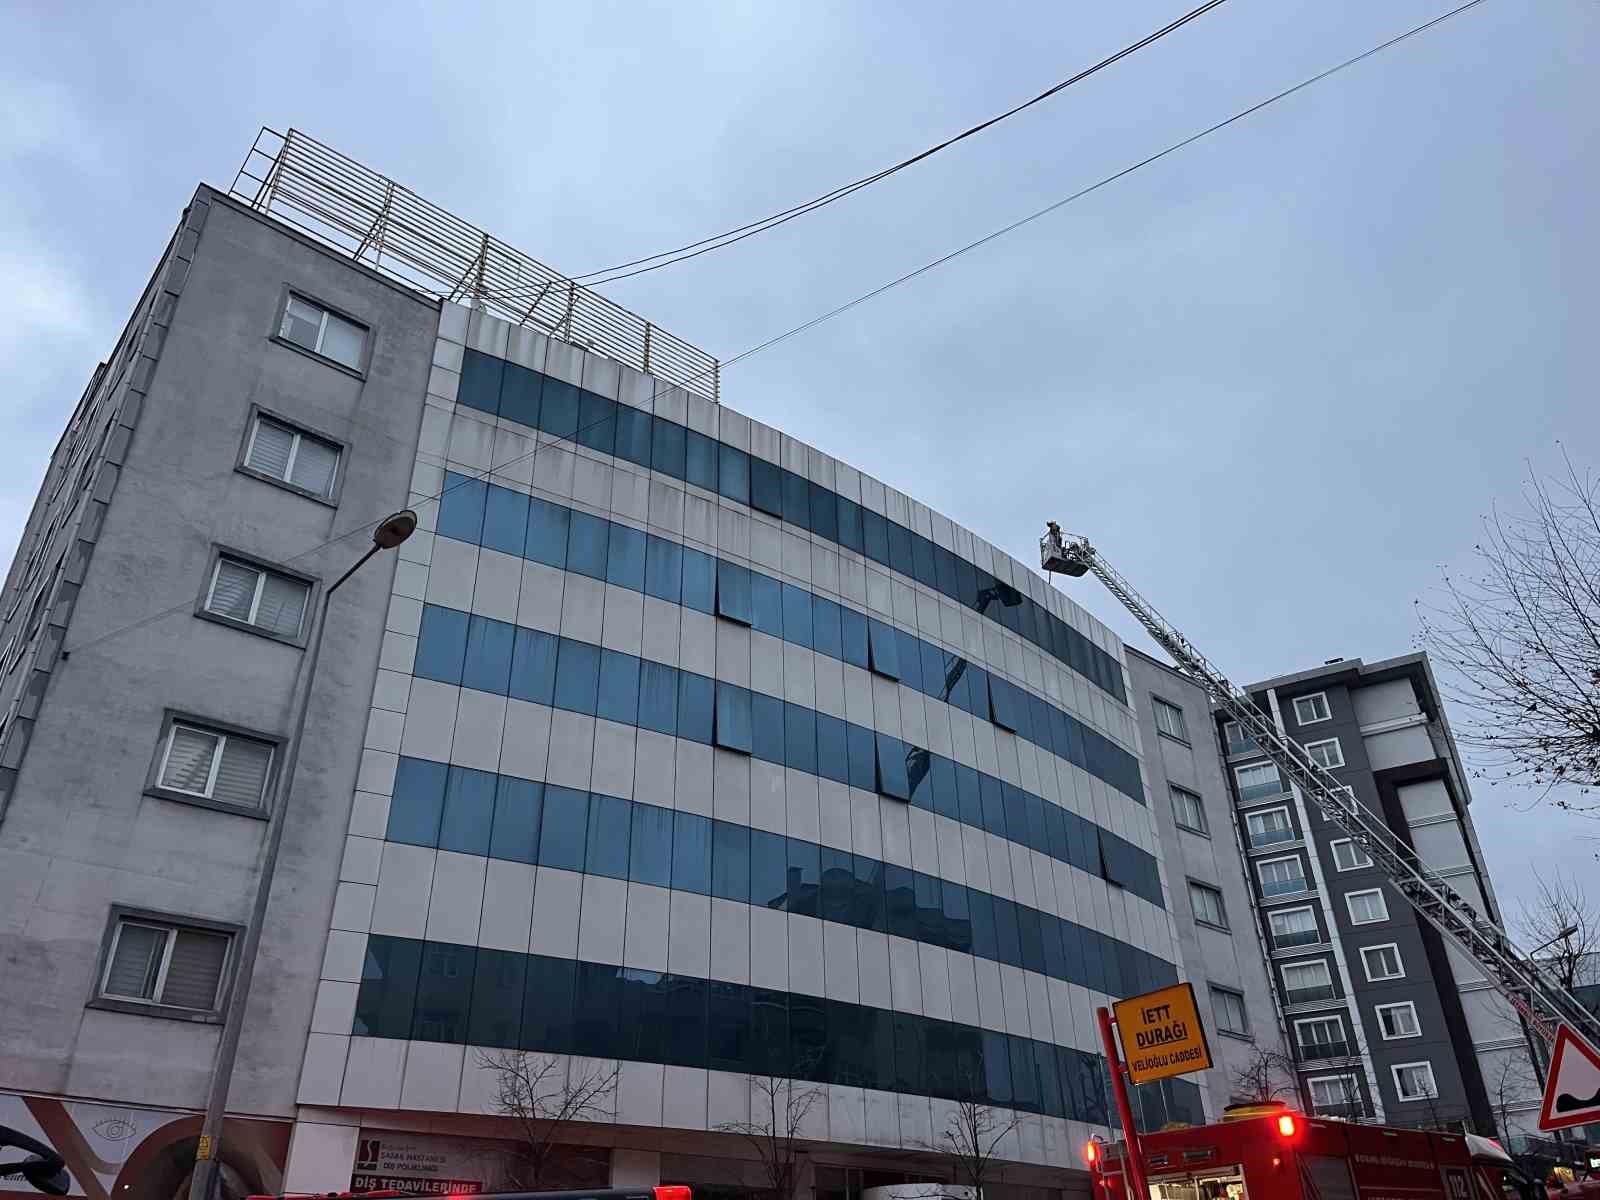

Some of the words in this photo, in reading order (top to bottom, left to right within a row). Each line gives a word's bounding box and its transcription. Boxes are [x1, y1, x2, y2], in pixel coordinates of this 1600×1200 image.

[1142, 1004, 1170, 1025] İETT
[1136, 1021, 1188, 1047] DURAĞI
[355, 1176, 377, 1191] DİŞ
[381, 1178, 477, 1194] TEDAVİLERİNDE
